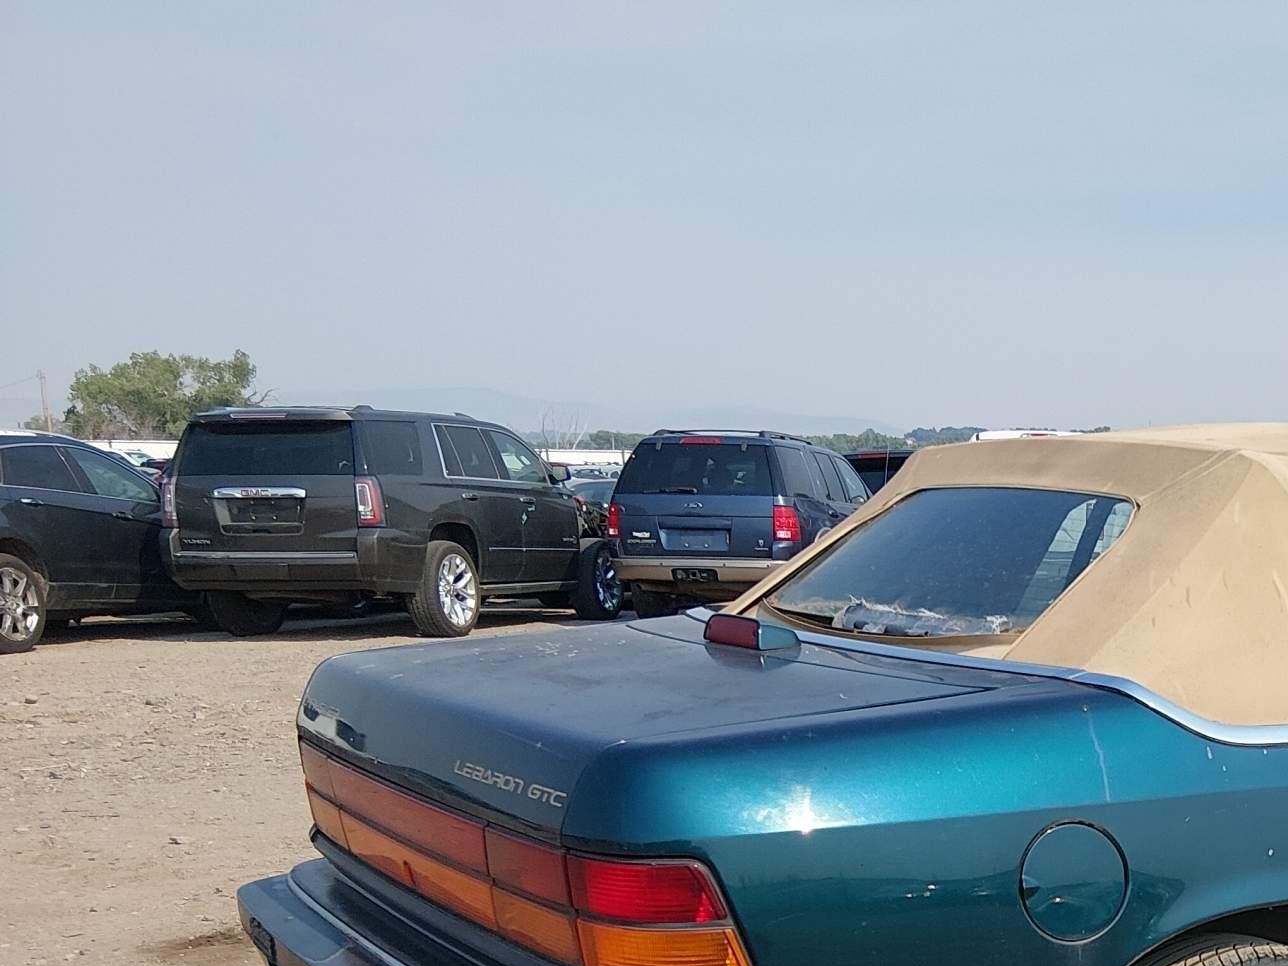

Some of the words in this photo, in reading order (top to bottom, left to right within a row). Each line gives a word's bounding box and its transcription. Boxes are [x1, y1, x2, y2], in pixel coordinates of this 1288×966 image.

[240, 489, 269, 497] GMC
[453, 759, 525, 795] LEBARON
[527, 783, 568, 808] GTC
